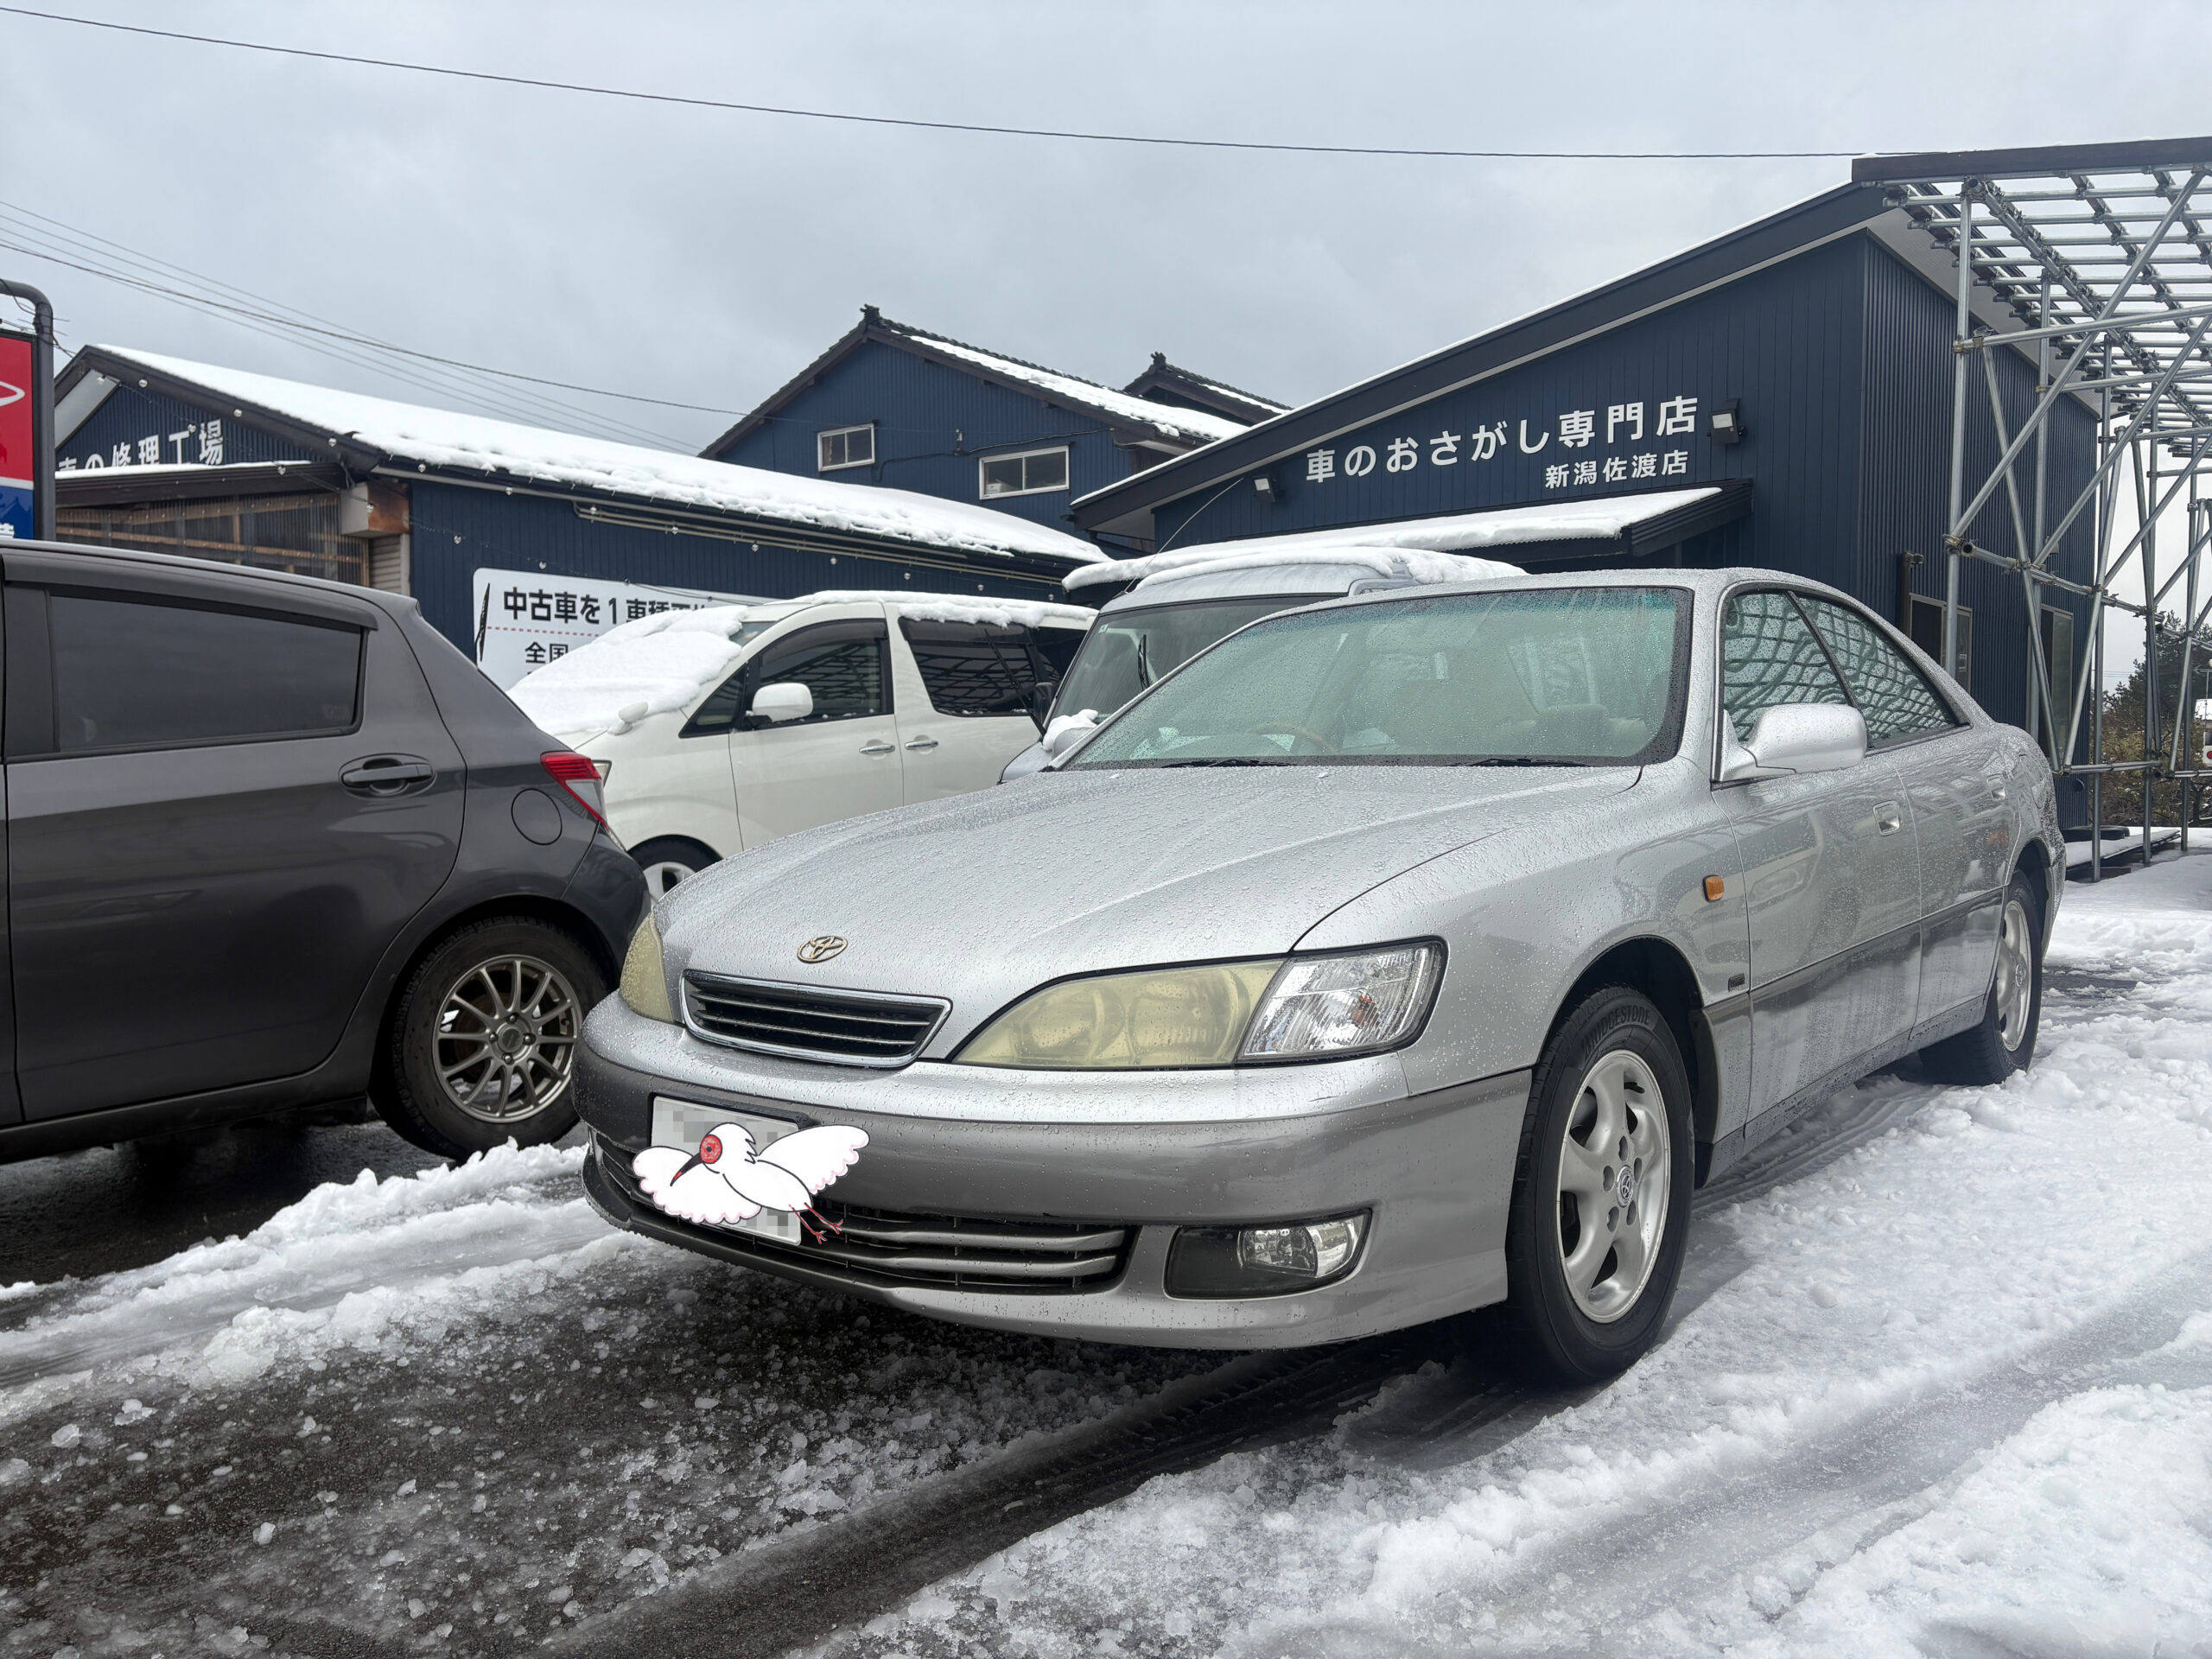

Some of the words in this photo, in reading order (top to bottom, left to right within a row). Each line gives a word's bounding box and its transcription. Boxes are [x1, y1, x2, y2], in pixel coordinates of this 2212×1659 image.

[1306, 396, 1699, 483] 車のおさがし専門店
[1545, 449, 1689, 490] 新潟佐渡店
[1585, 1005, 1651, 1059] BRIDGESTONE
